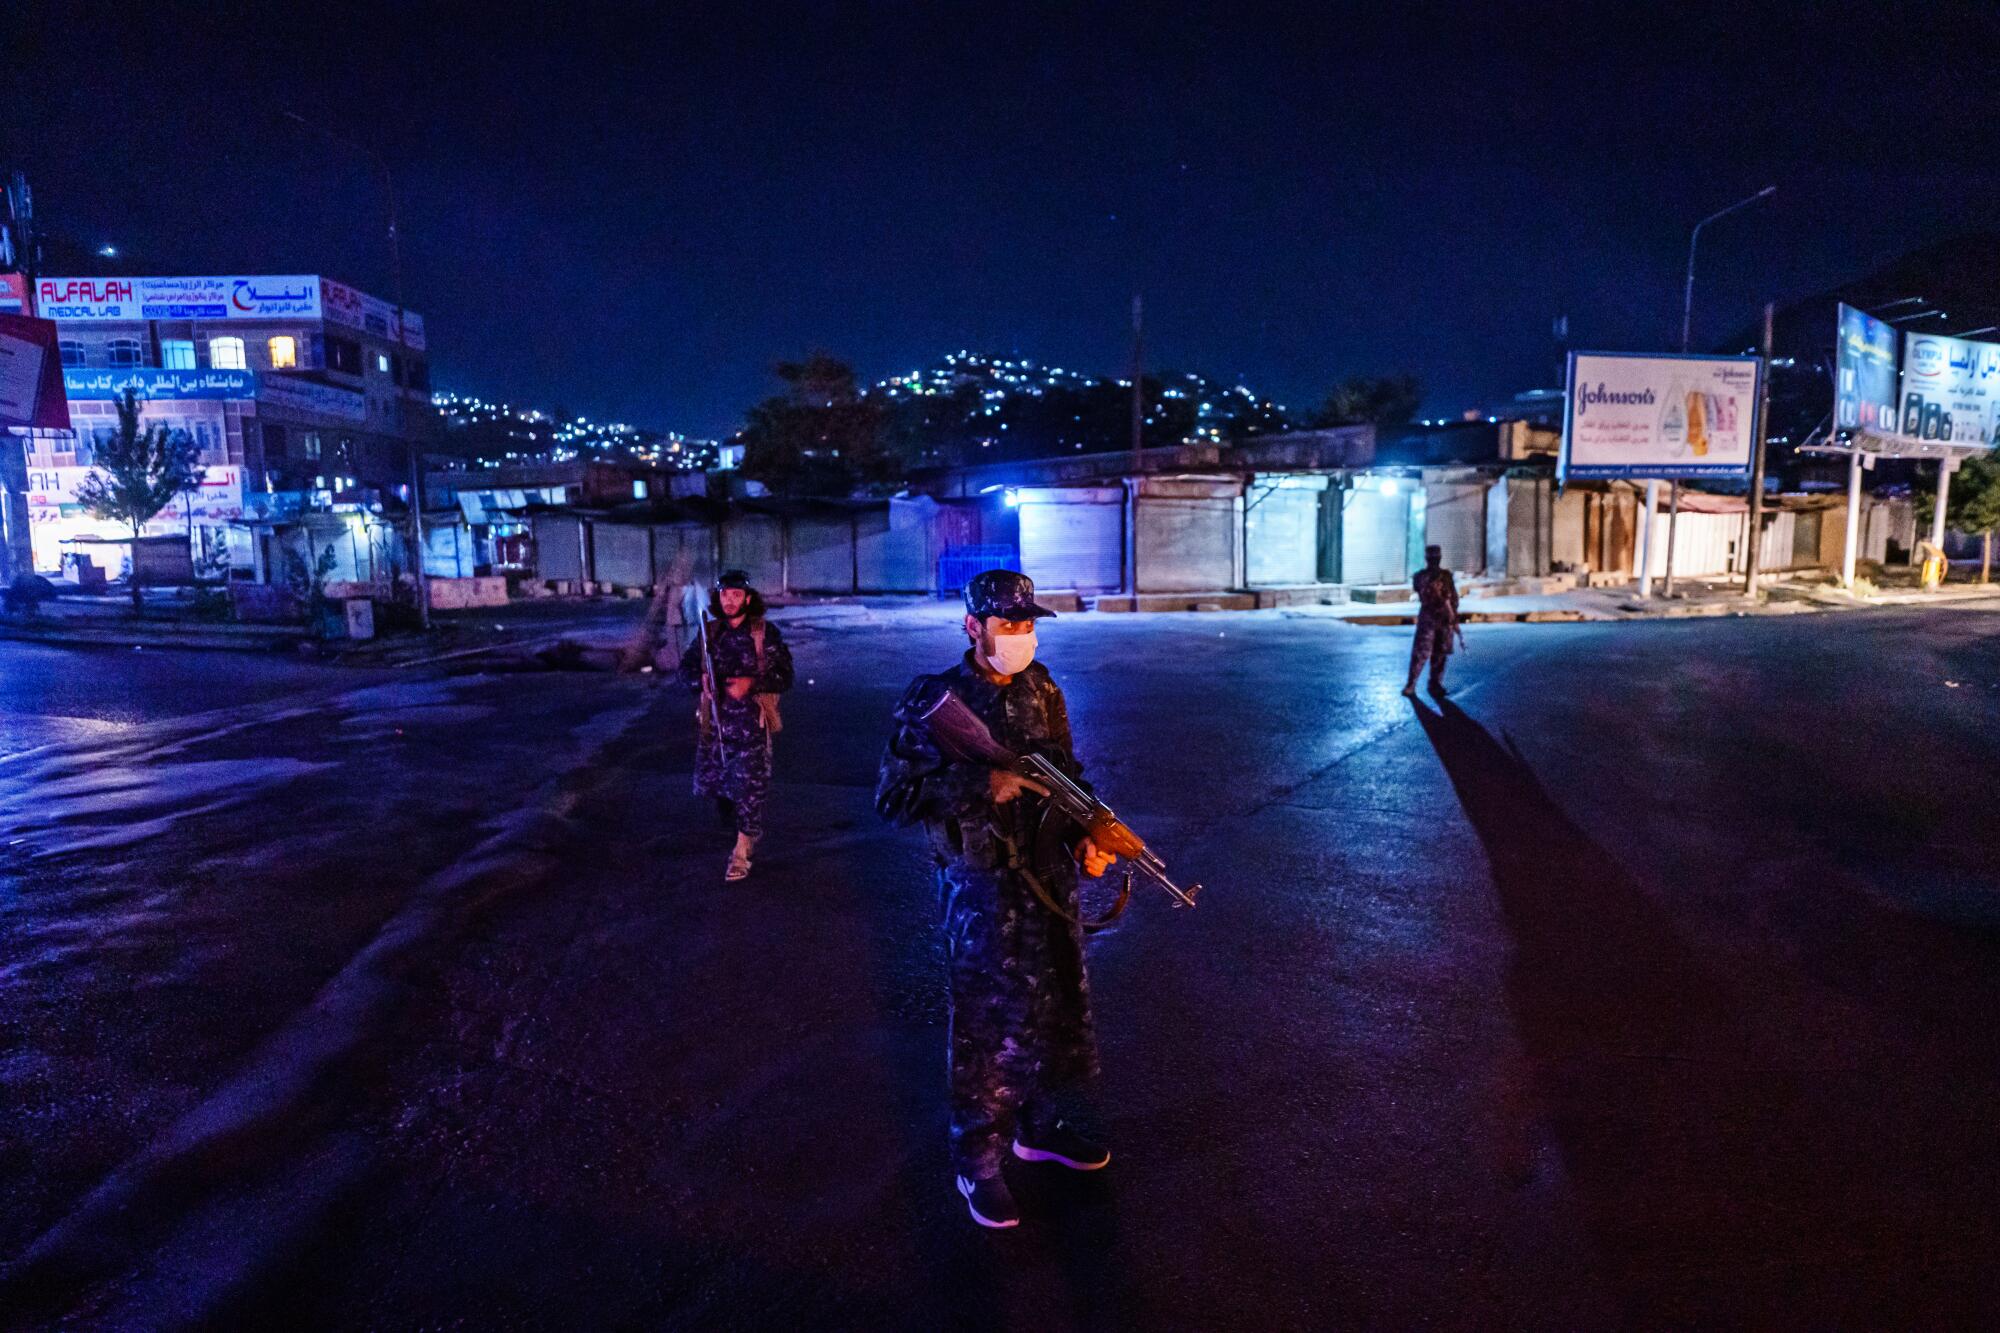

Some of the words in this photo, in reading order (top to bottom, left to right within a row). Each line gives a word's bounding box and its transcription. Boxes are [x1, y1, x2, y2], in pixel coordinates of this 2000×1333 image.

[41, 281, 133, 302] ALFALAH
[232, 280, 313, 311] الفلاح
[48, 305, 96, 318] MEDICAL
[98, 305, 121, 317] LAB
[64, 375, 85, 390] سعا
[86, 374, 112, 393] کتاب
[199, 374, 244, 391] نمایشگاه
[1578, 382, 1655, 416] Johnson's
